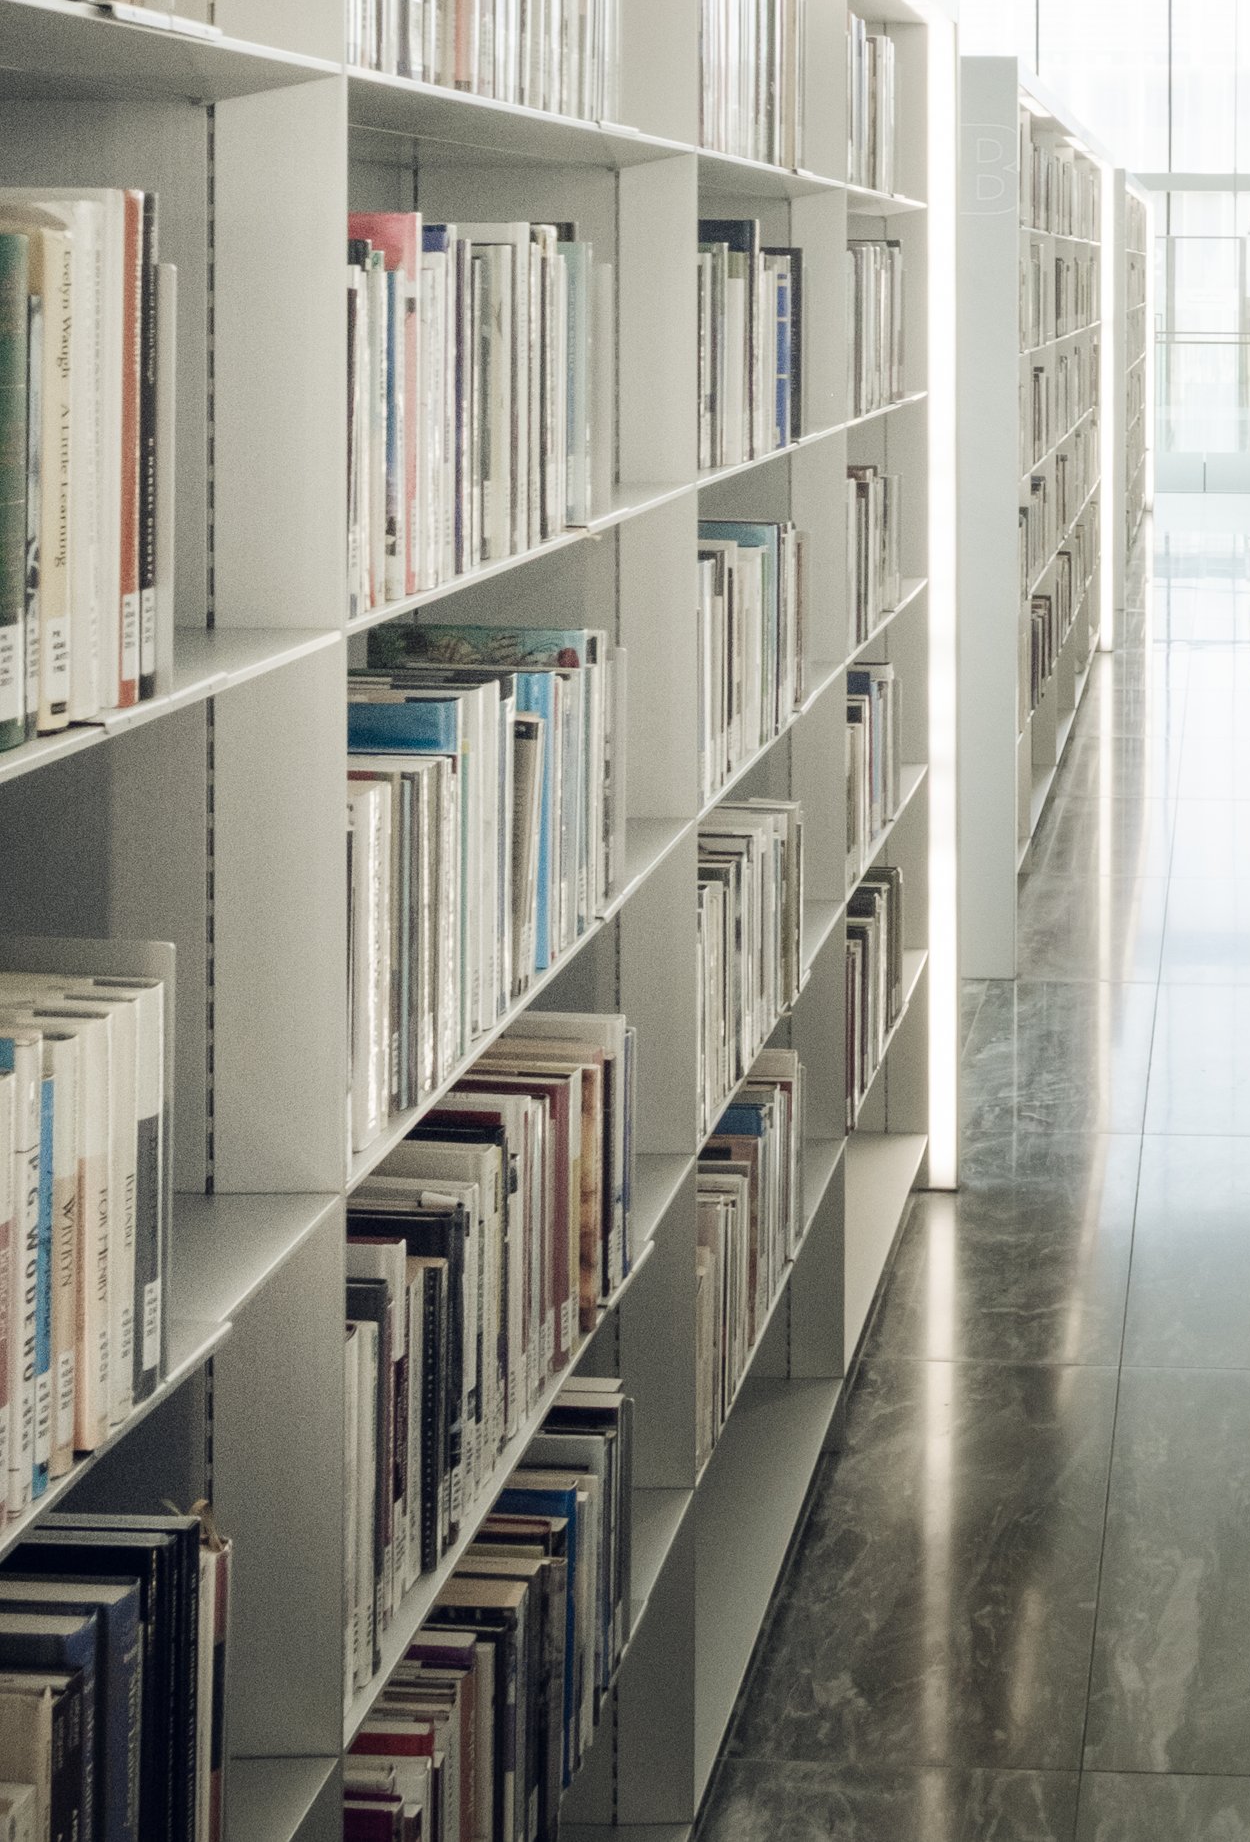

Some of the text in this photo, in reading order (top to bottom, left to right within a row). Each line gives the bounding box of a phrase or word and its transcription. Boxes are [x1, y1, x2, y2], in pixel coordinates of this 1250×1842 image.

[57, 251, 73, 310] Evelyn
[57, 315, 73, 379] Waugh
[54, 481, 69, 567] Learning
[61, 1194, 76, 1288] WRYKYN
[124, 1172, 136, 1250] RELIABLE
[23, 1223, 38, 1383] WODEHO
